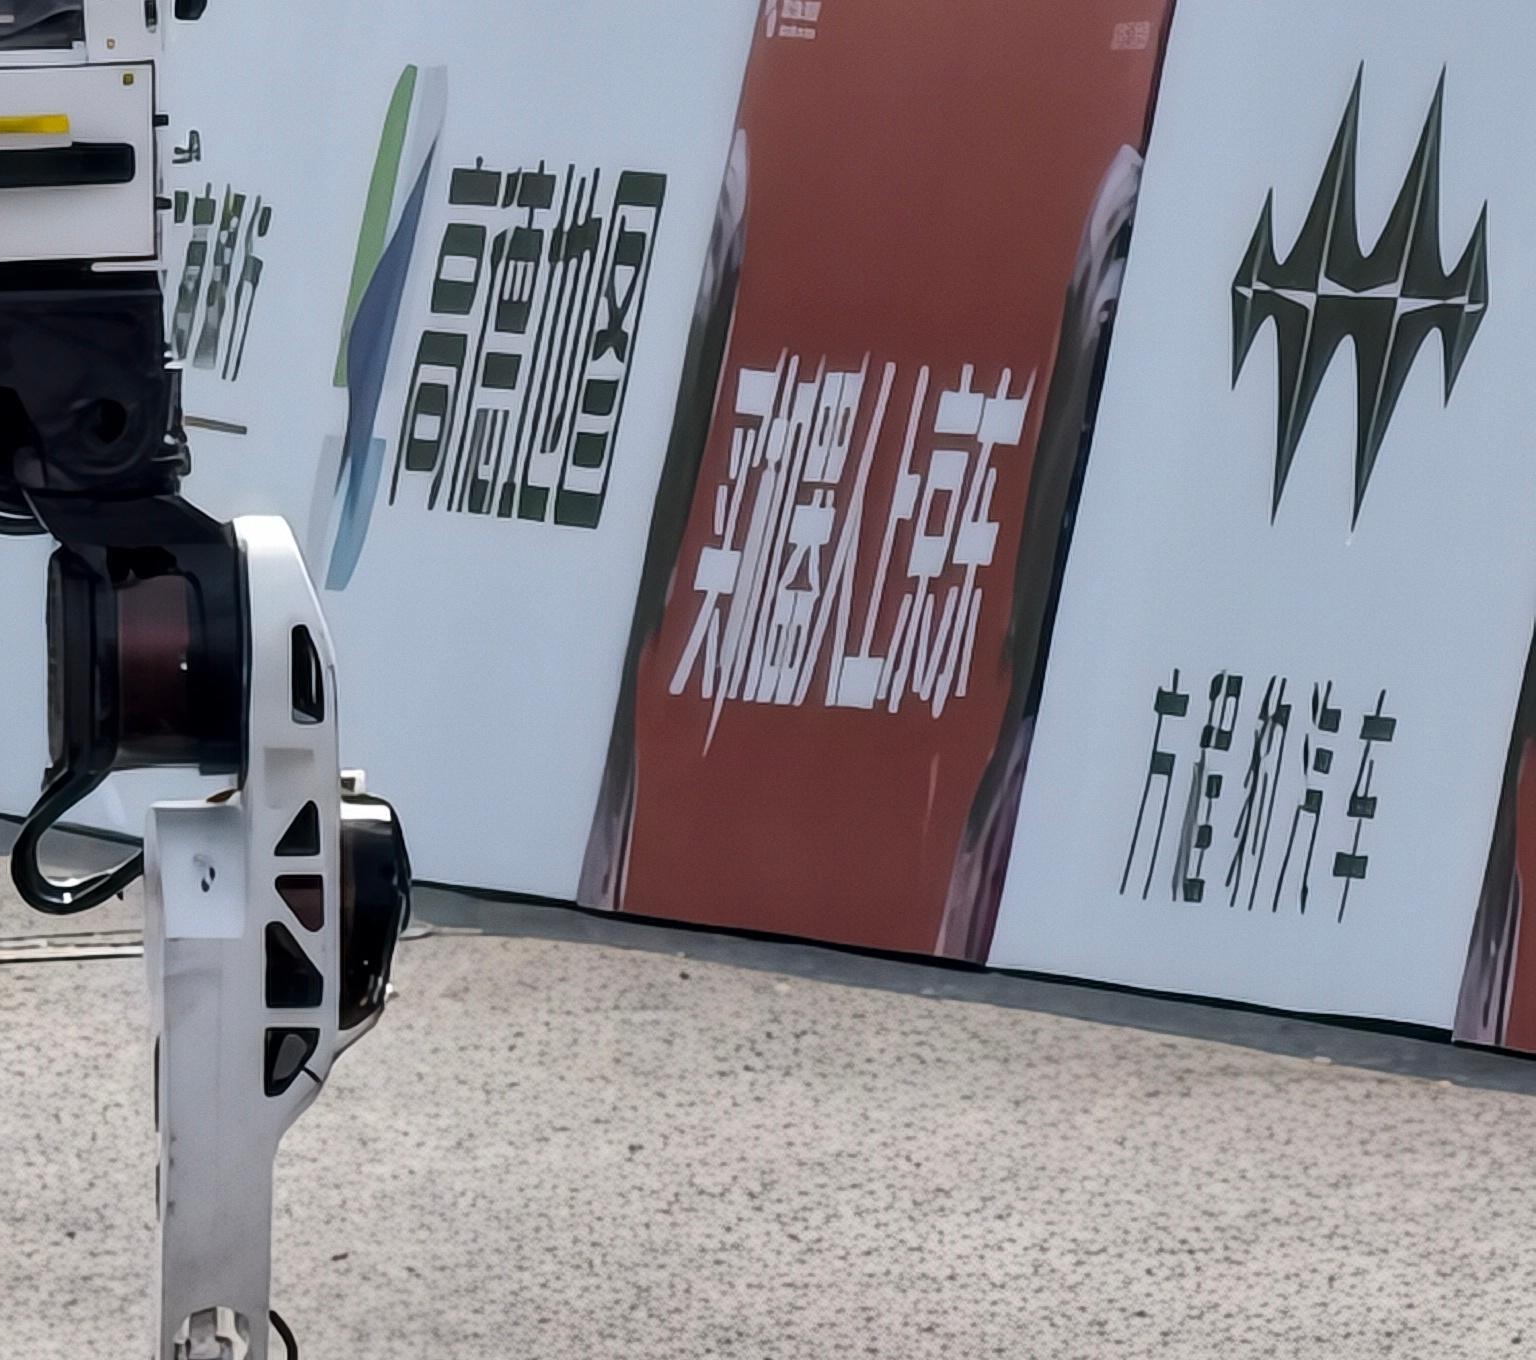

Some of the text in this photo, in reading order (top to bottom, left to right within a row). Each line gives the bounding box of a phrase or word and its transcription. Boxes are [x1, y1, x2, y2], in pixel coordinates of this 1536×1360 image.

[388, 155, 667, 530] 高德地图
[668, 346, 1039, 758] 买机器人上京东
[1120, 666, 1397, 924] 方程豹汽车
